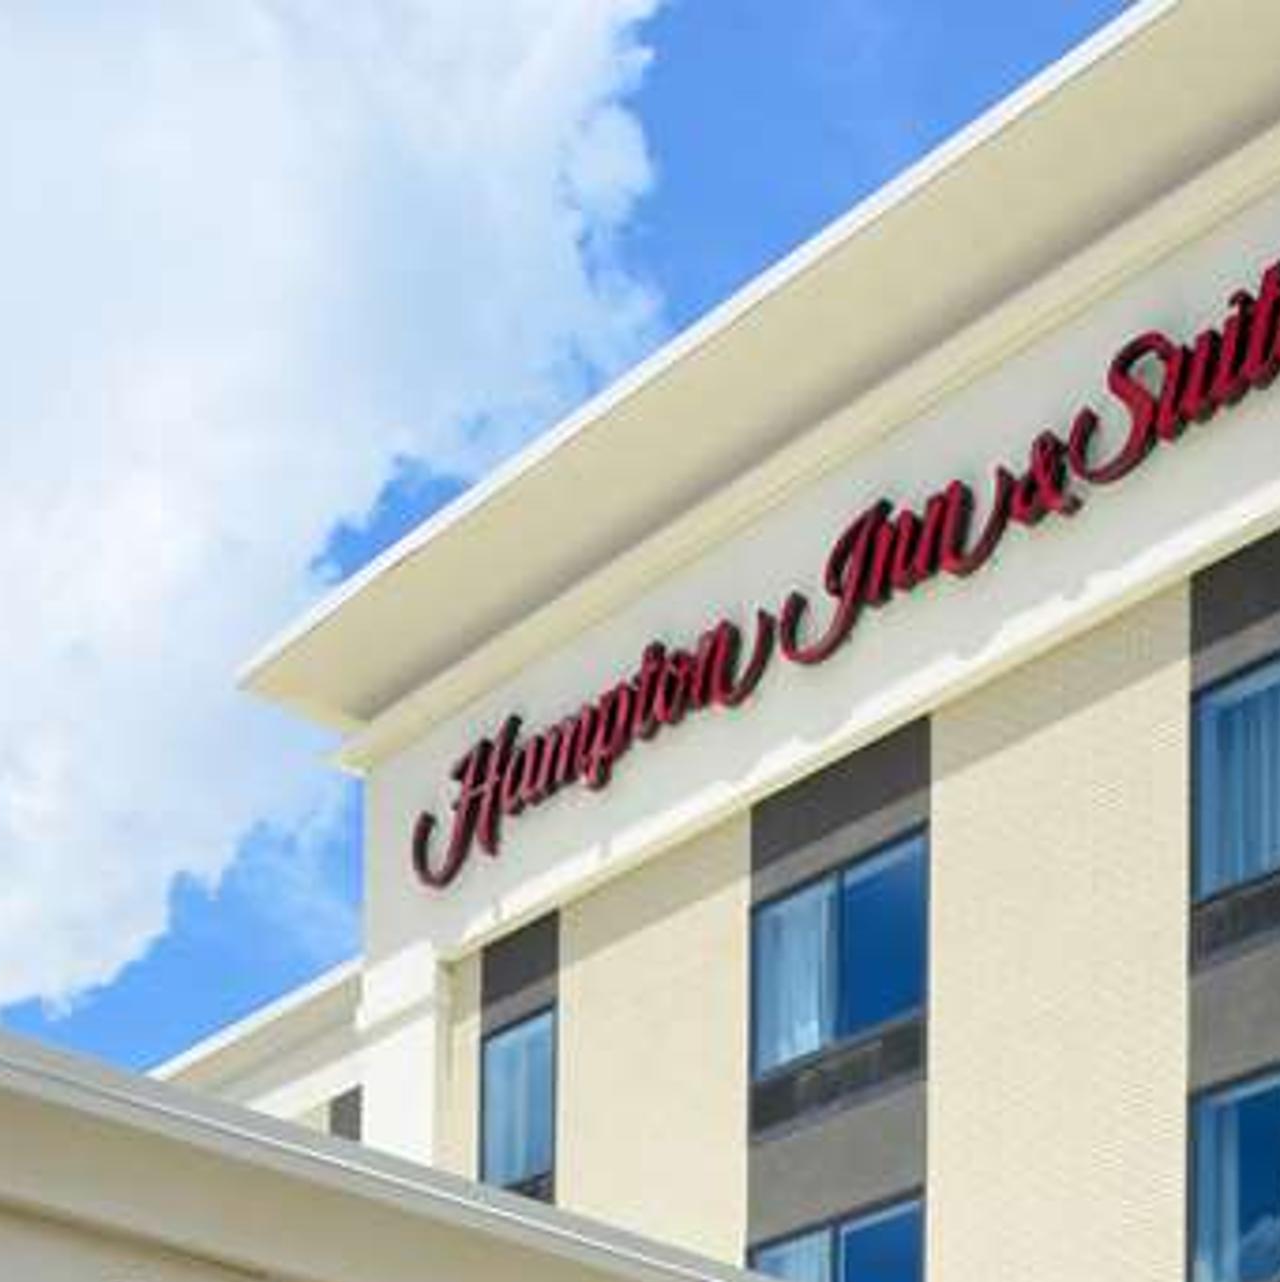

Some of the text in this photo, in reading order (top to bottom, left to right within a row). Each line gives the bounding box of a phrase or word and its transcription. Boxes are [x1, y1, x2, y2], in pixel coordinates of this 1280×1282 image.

[413, 609, 775, 888] Hampton
[779, 466, 1014, 664] Inn
[1009, 430, 1084, 525] &
